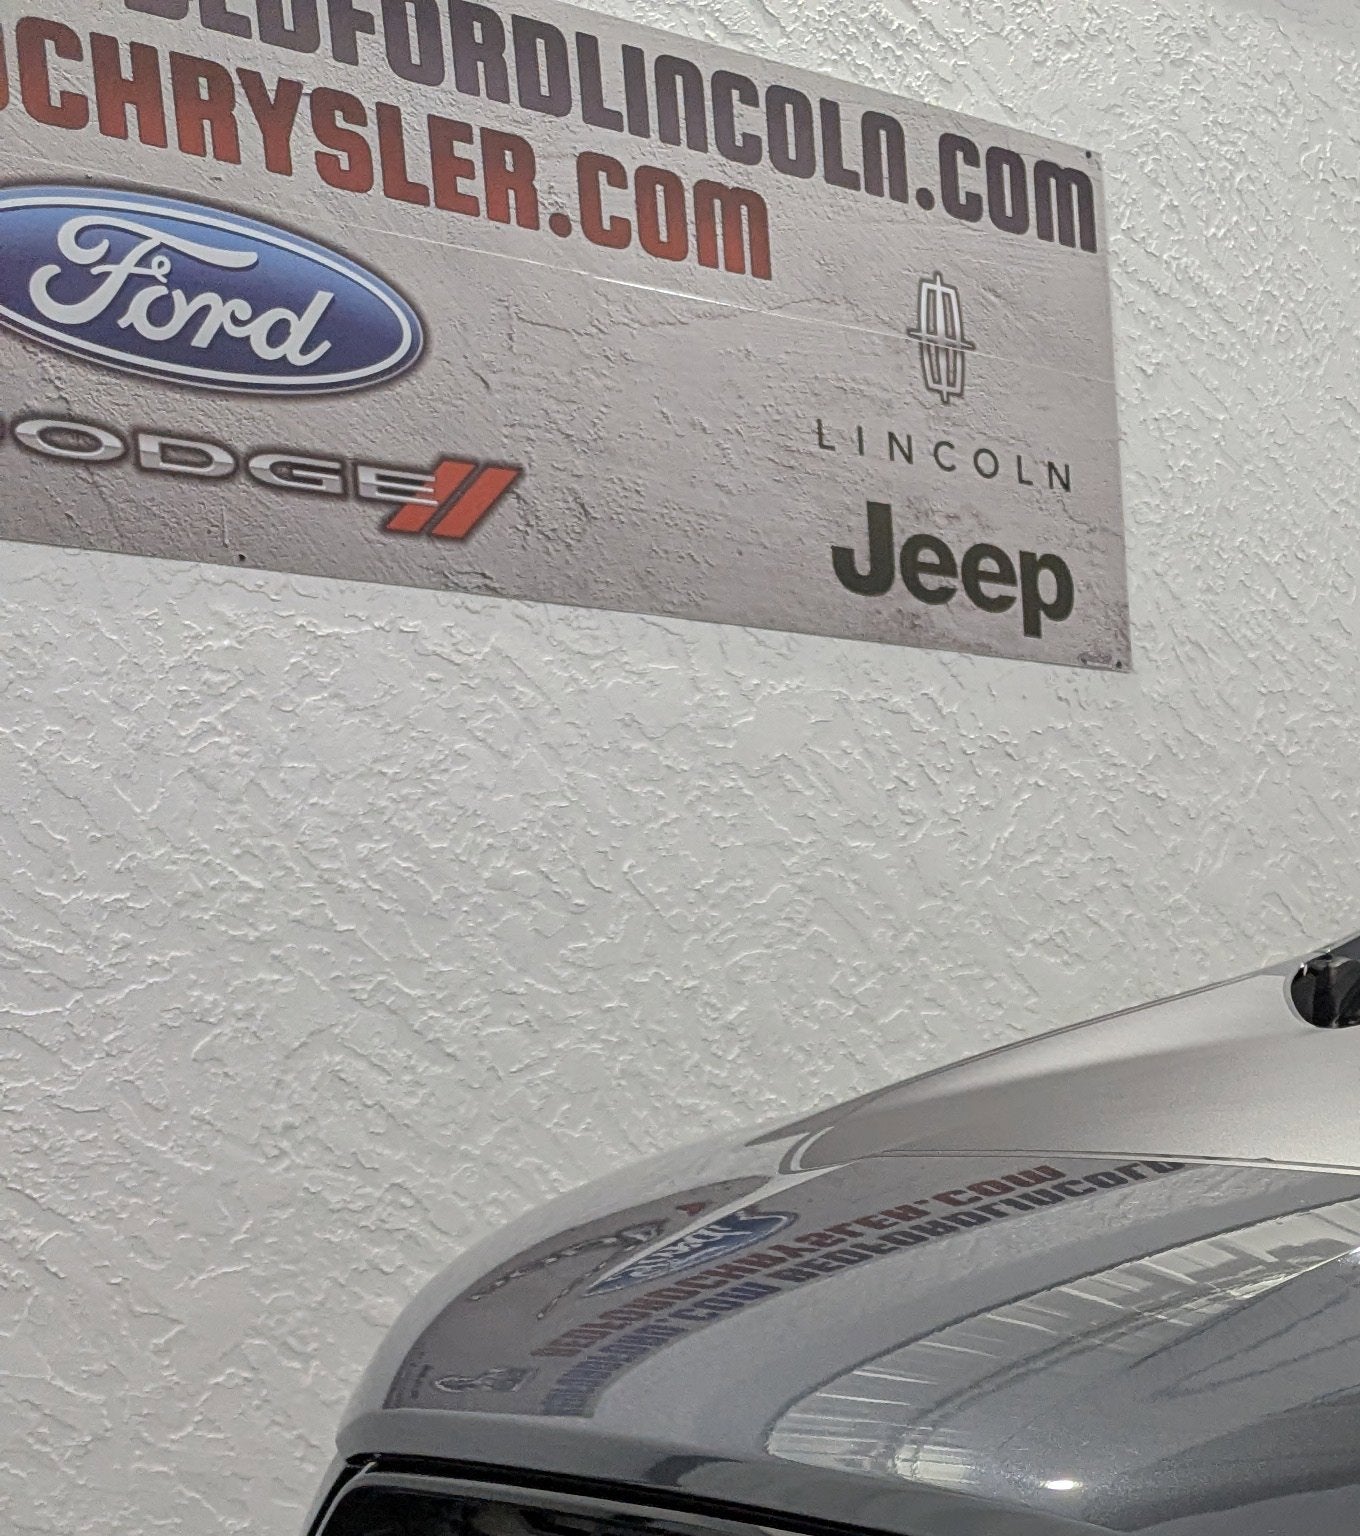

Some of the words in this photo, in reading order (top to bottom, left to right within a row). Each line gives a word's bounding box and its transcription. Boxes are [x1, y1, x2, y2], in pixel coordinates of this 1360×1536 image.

[0, 14, 773, 281] CHRYSLER.COM
[124, 0, 1098, 254] FORDLINCOLN.COM
[28, 214, 336, 367] Ford
[0, 419, 439, 507] ODGE
[816, 418, 1072, 493] LINCOLN
[830, 500, 1075, 639] Jeep
